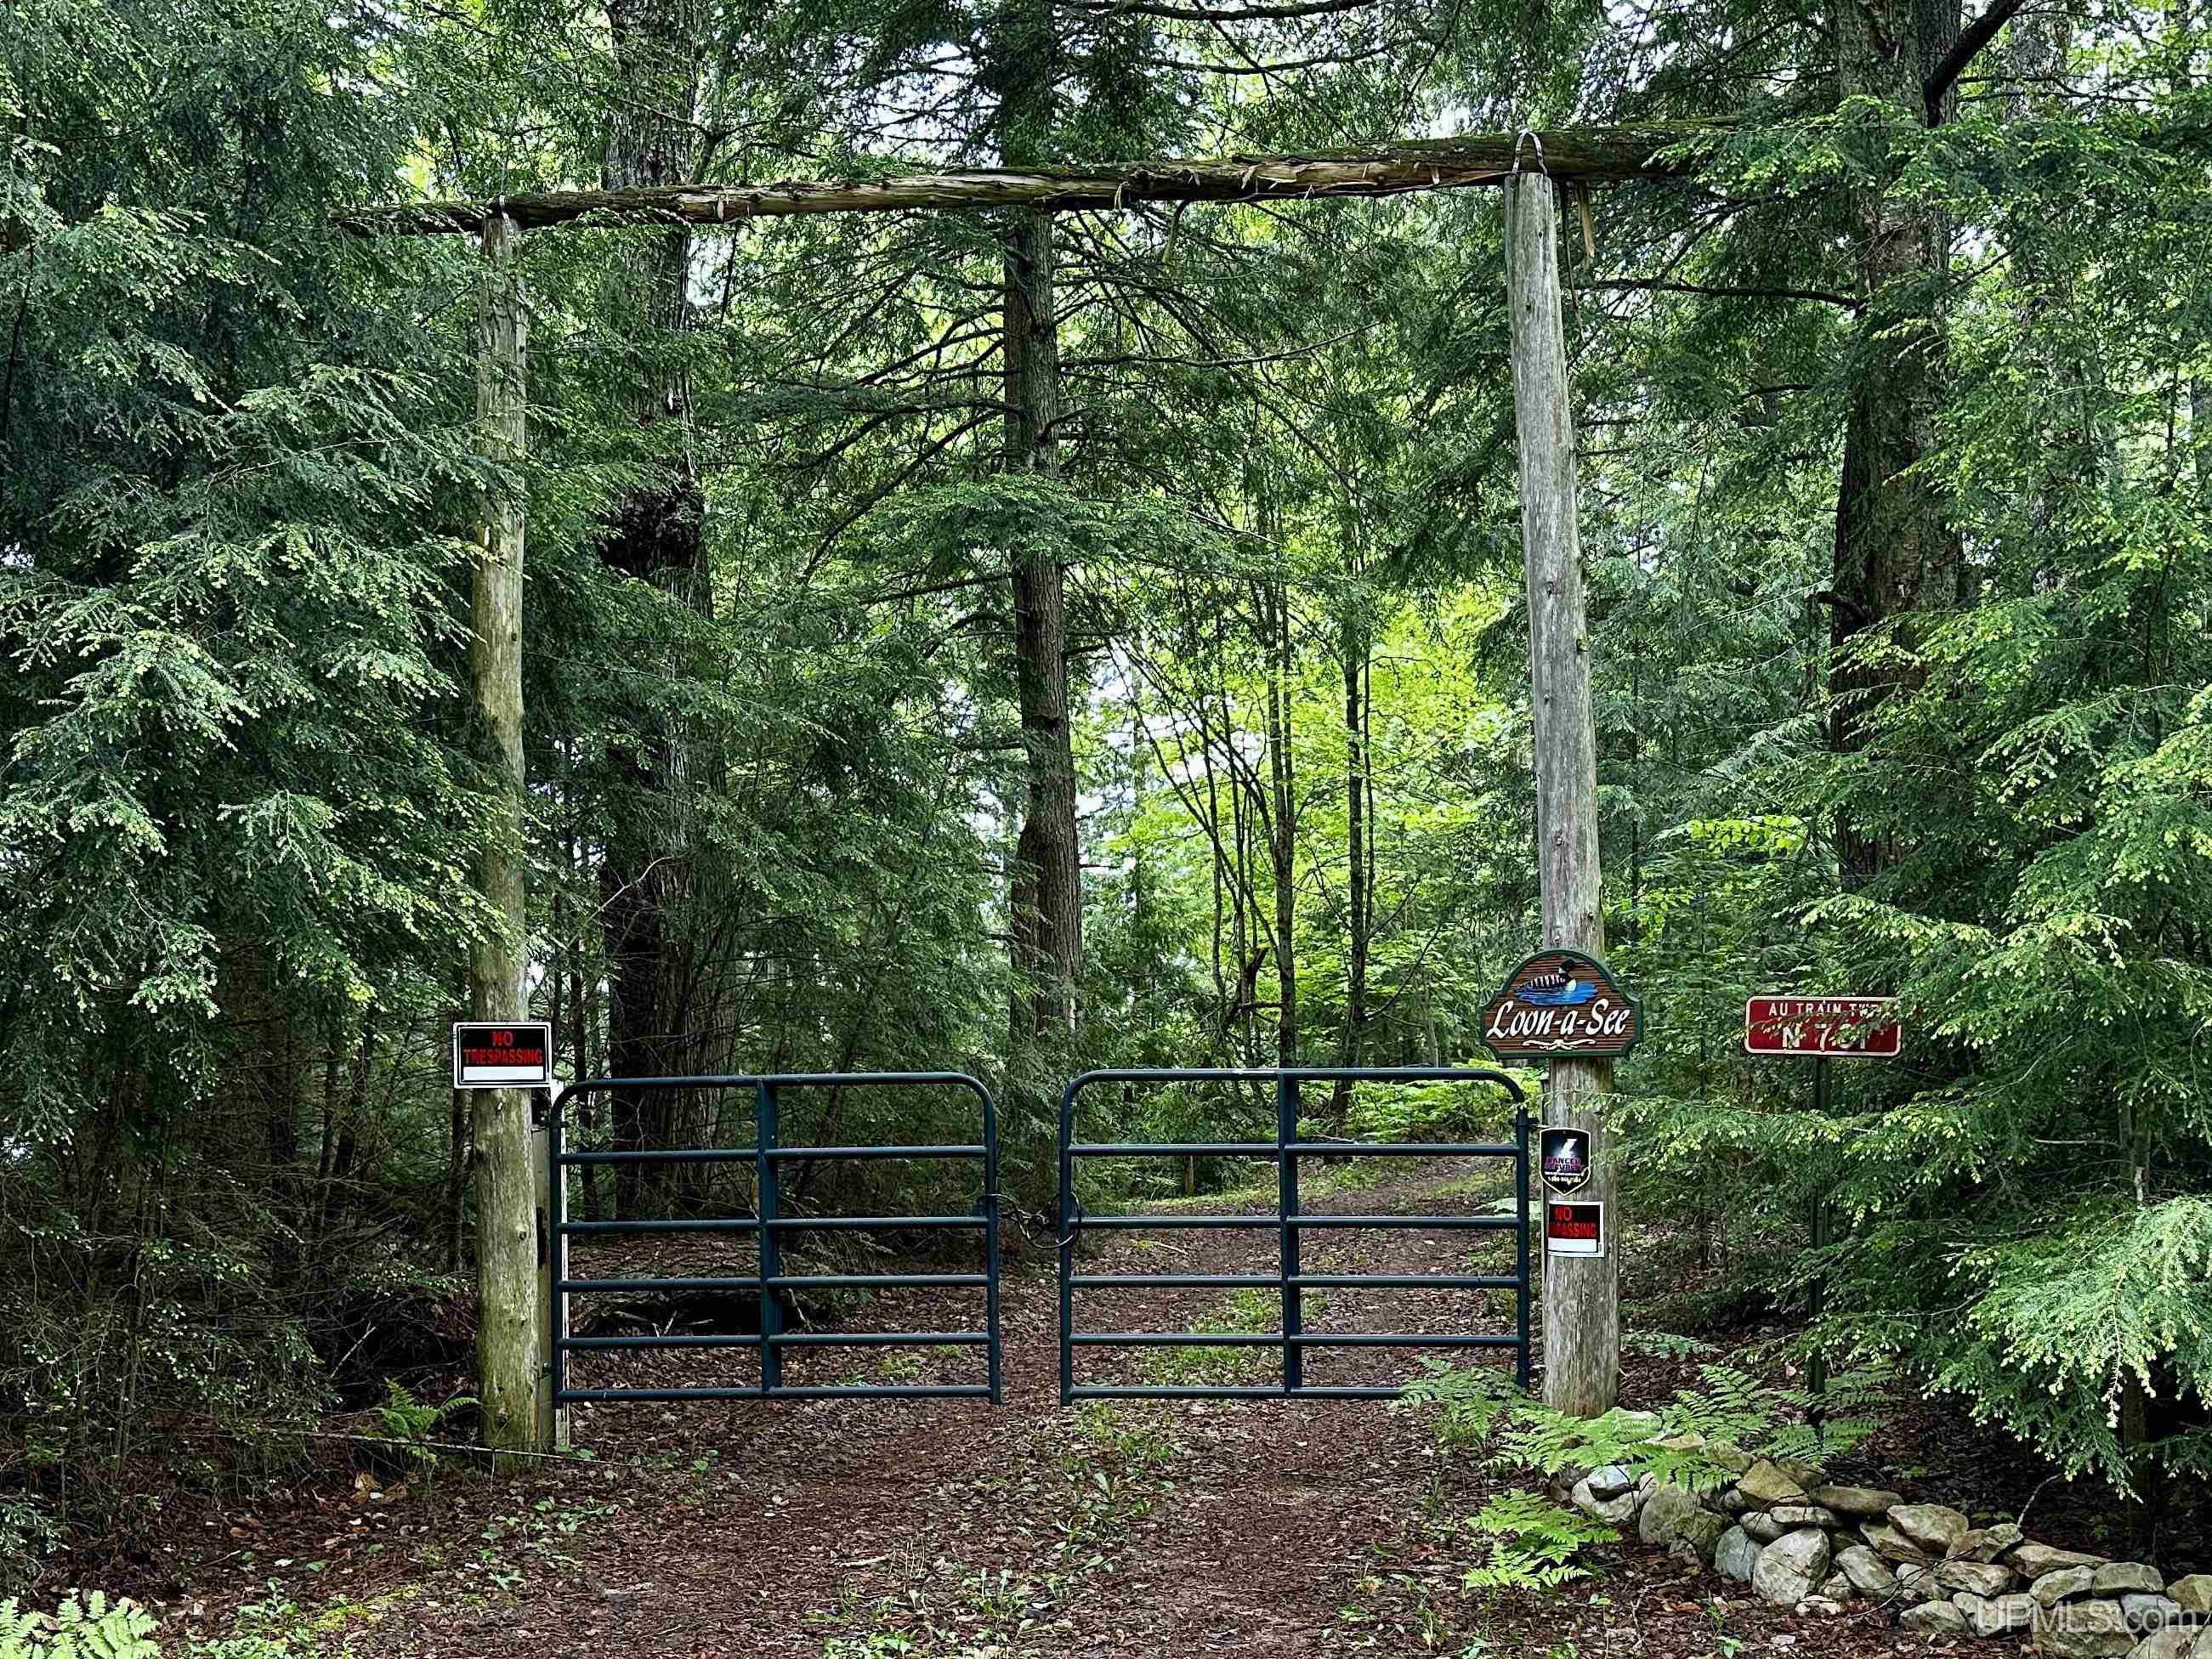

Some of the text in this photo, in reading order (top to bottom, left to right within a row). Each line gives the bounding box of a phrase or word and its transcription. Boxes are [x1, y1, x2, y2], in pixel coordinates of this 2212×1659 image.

[1768, 1003, 1789, 1016] AU
[1796, 1003, 1841, 1015] TRAIN
[1486, 998, 1631, 1039] Loon-a-See
[492, 1030, 514, 1046] NO
[462, 1048, 544, 1065] TRESPASSING
[1555, 1206, 1573, 1222] NO
